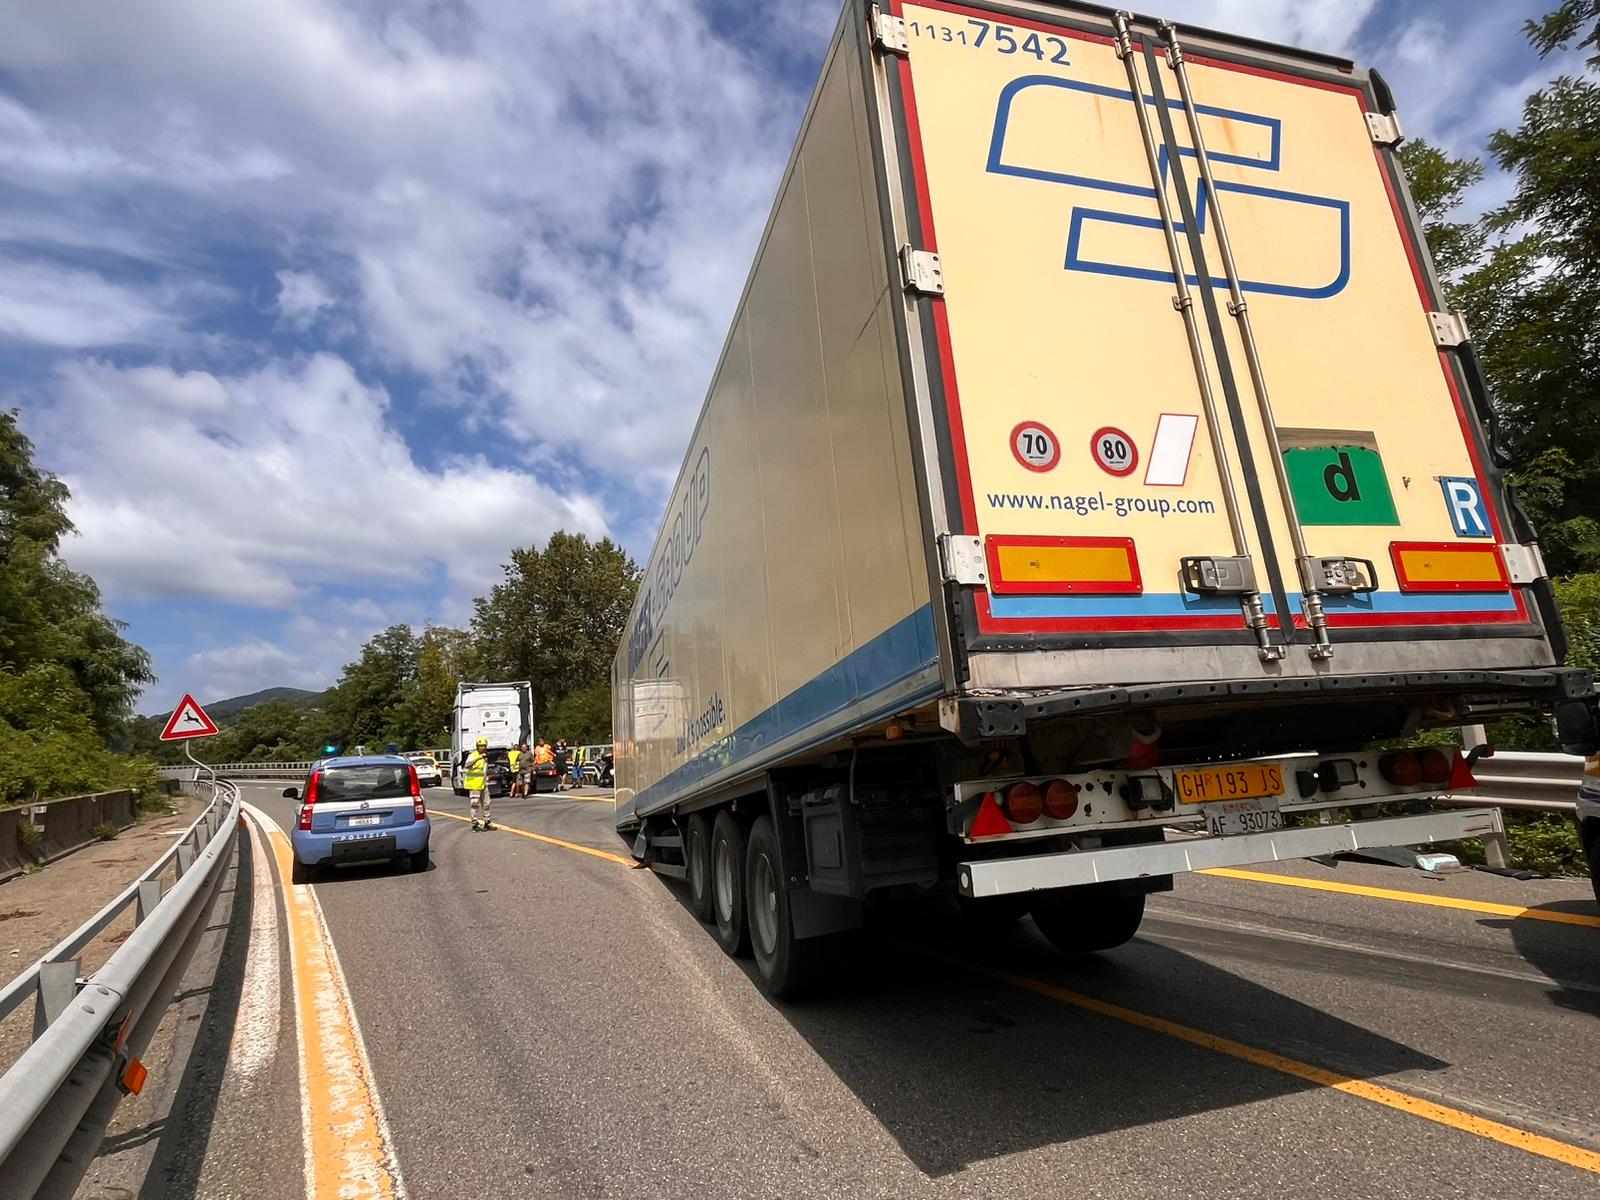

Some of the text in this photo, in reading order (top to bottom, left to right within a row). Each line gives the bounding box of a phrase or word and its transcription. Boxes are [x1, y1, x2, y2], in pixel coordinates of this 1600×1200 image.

[1022, 433, 1048, 455] 70
[1102, 439, 1127, 460] 80
[1323, 452, 1361, 501] d
[986, 491, 1216, 518] www.nagel-group.com
[1447, 481, 1486, 531] R
[1261, 768, 1281, 792] JS
[1211, 815, 1227, 834] AF
[339, 831, 388, 842] POLIZIA
